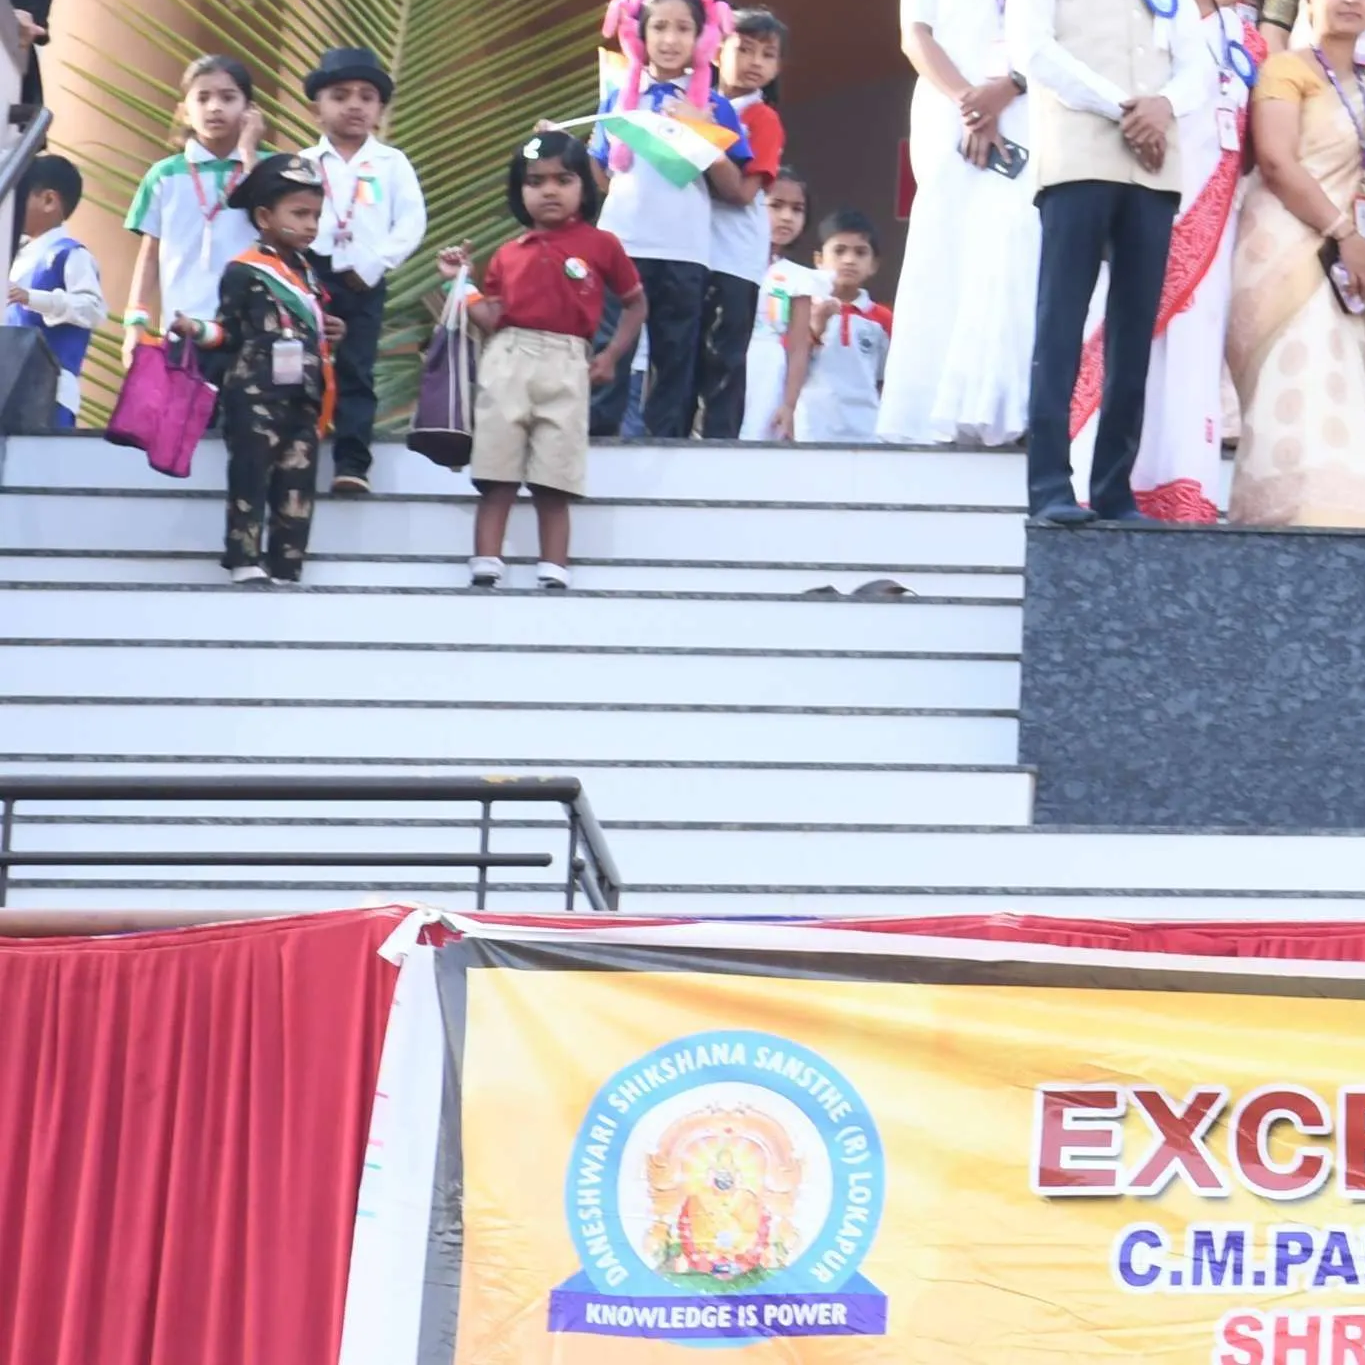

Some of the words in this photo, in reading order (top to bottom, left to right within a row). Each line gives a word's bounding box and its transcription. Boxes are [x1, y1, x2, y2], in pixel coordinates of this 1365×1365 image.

[606, 1043, 747, 1115] SHIKSHANA
[753, 1045, 854, 1124] SANSTHE
[835, 1124, 872, 1165] (R)
[577, 1112, 630, 1287] DANESHWARI
[808, 1172, 873, 1284] LOKAPUR
[585, 1302, 731, 1328] KNOWLEDGE
[738, 1306, 758, 1326] IS
[764, 1302, 848, 1327] POWER
